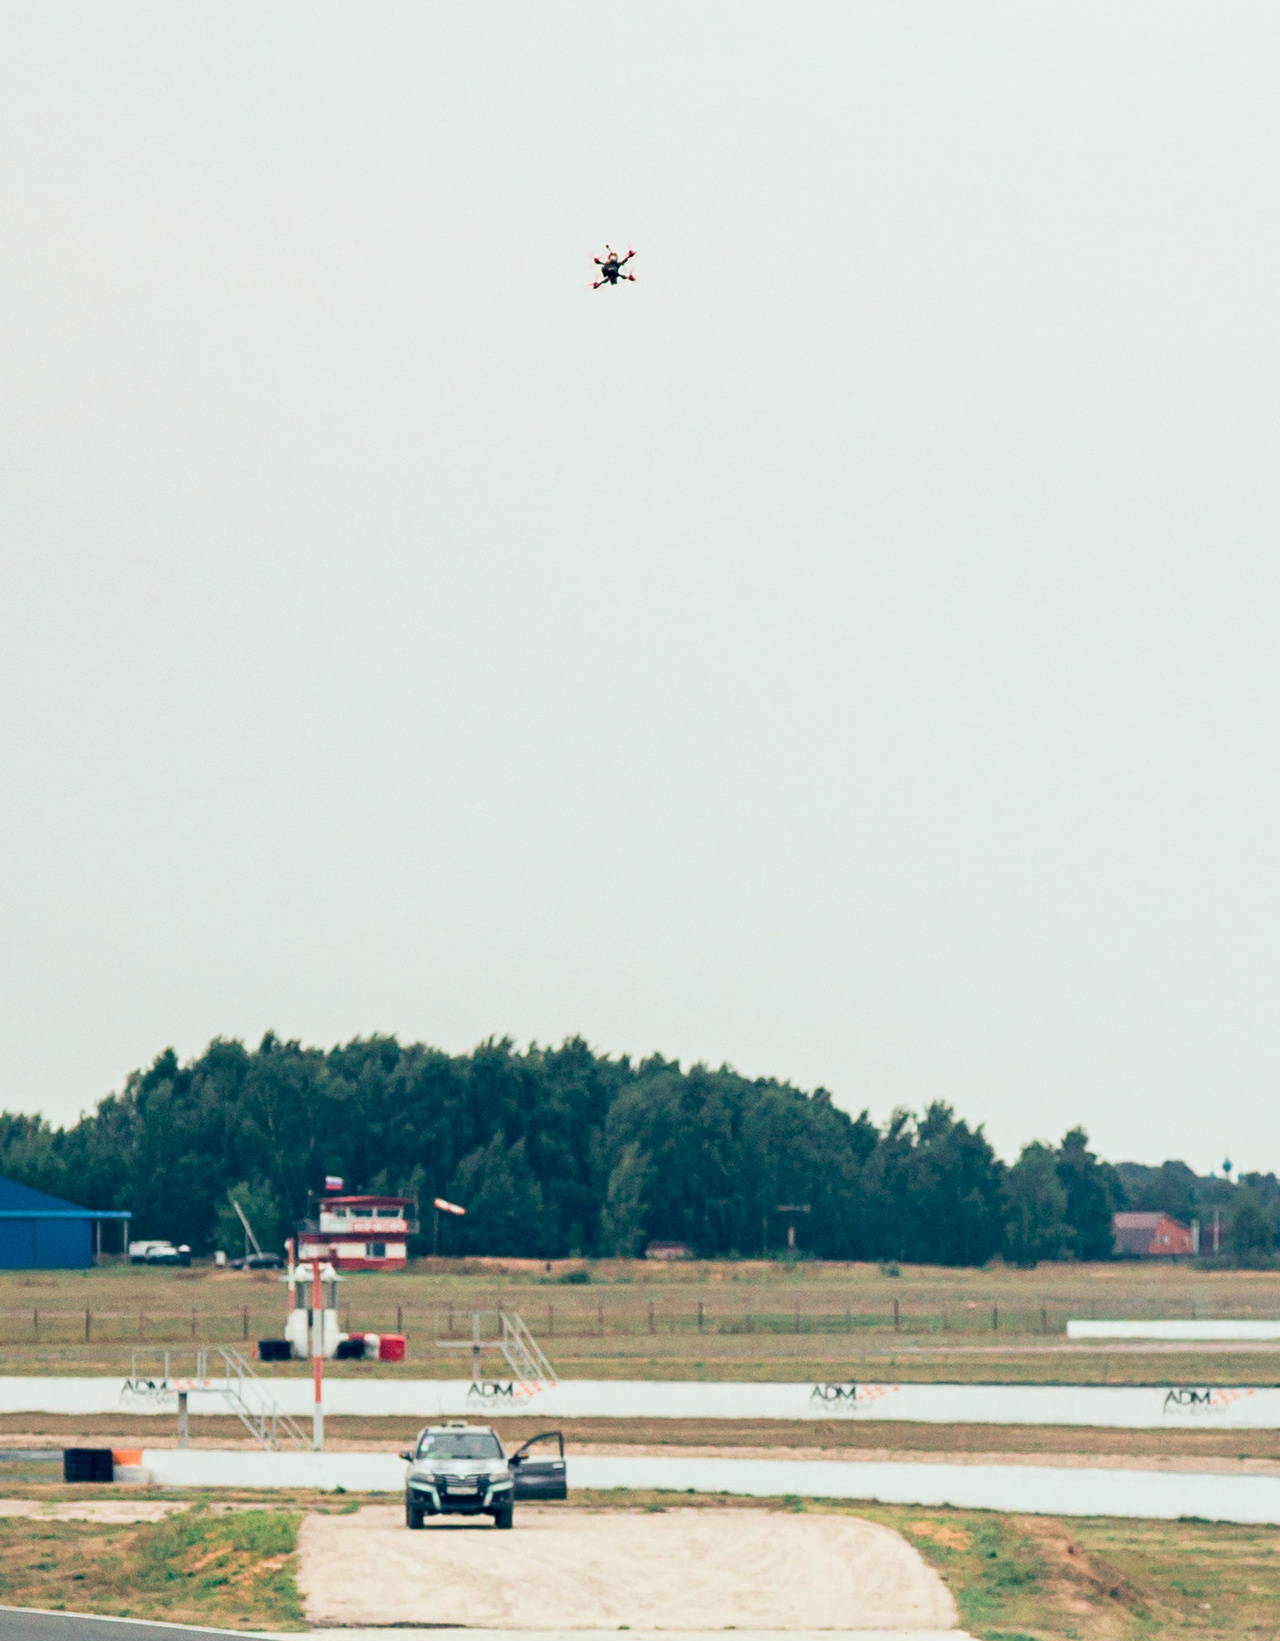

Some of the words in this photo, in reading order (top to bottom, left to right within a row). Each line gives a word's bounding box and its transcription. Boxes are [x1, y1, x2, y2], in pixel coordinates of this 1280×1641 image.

[467, 1381, 513, 1398] ADM
[810, 1383, 856, 1401] ADM
[1164, 1388, 1211, 1405] ADM
